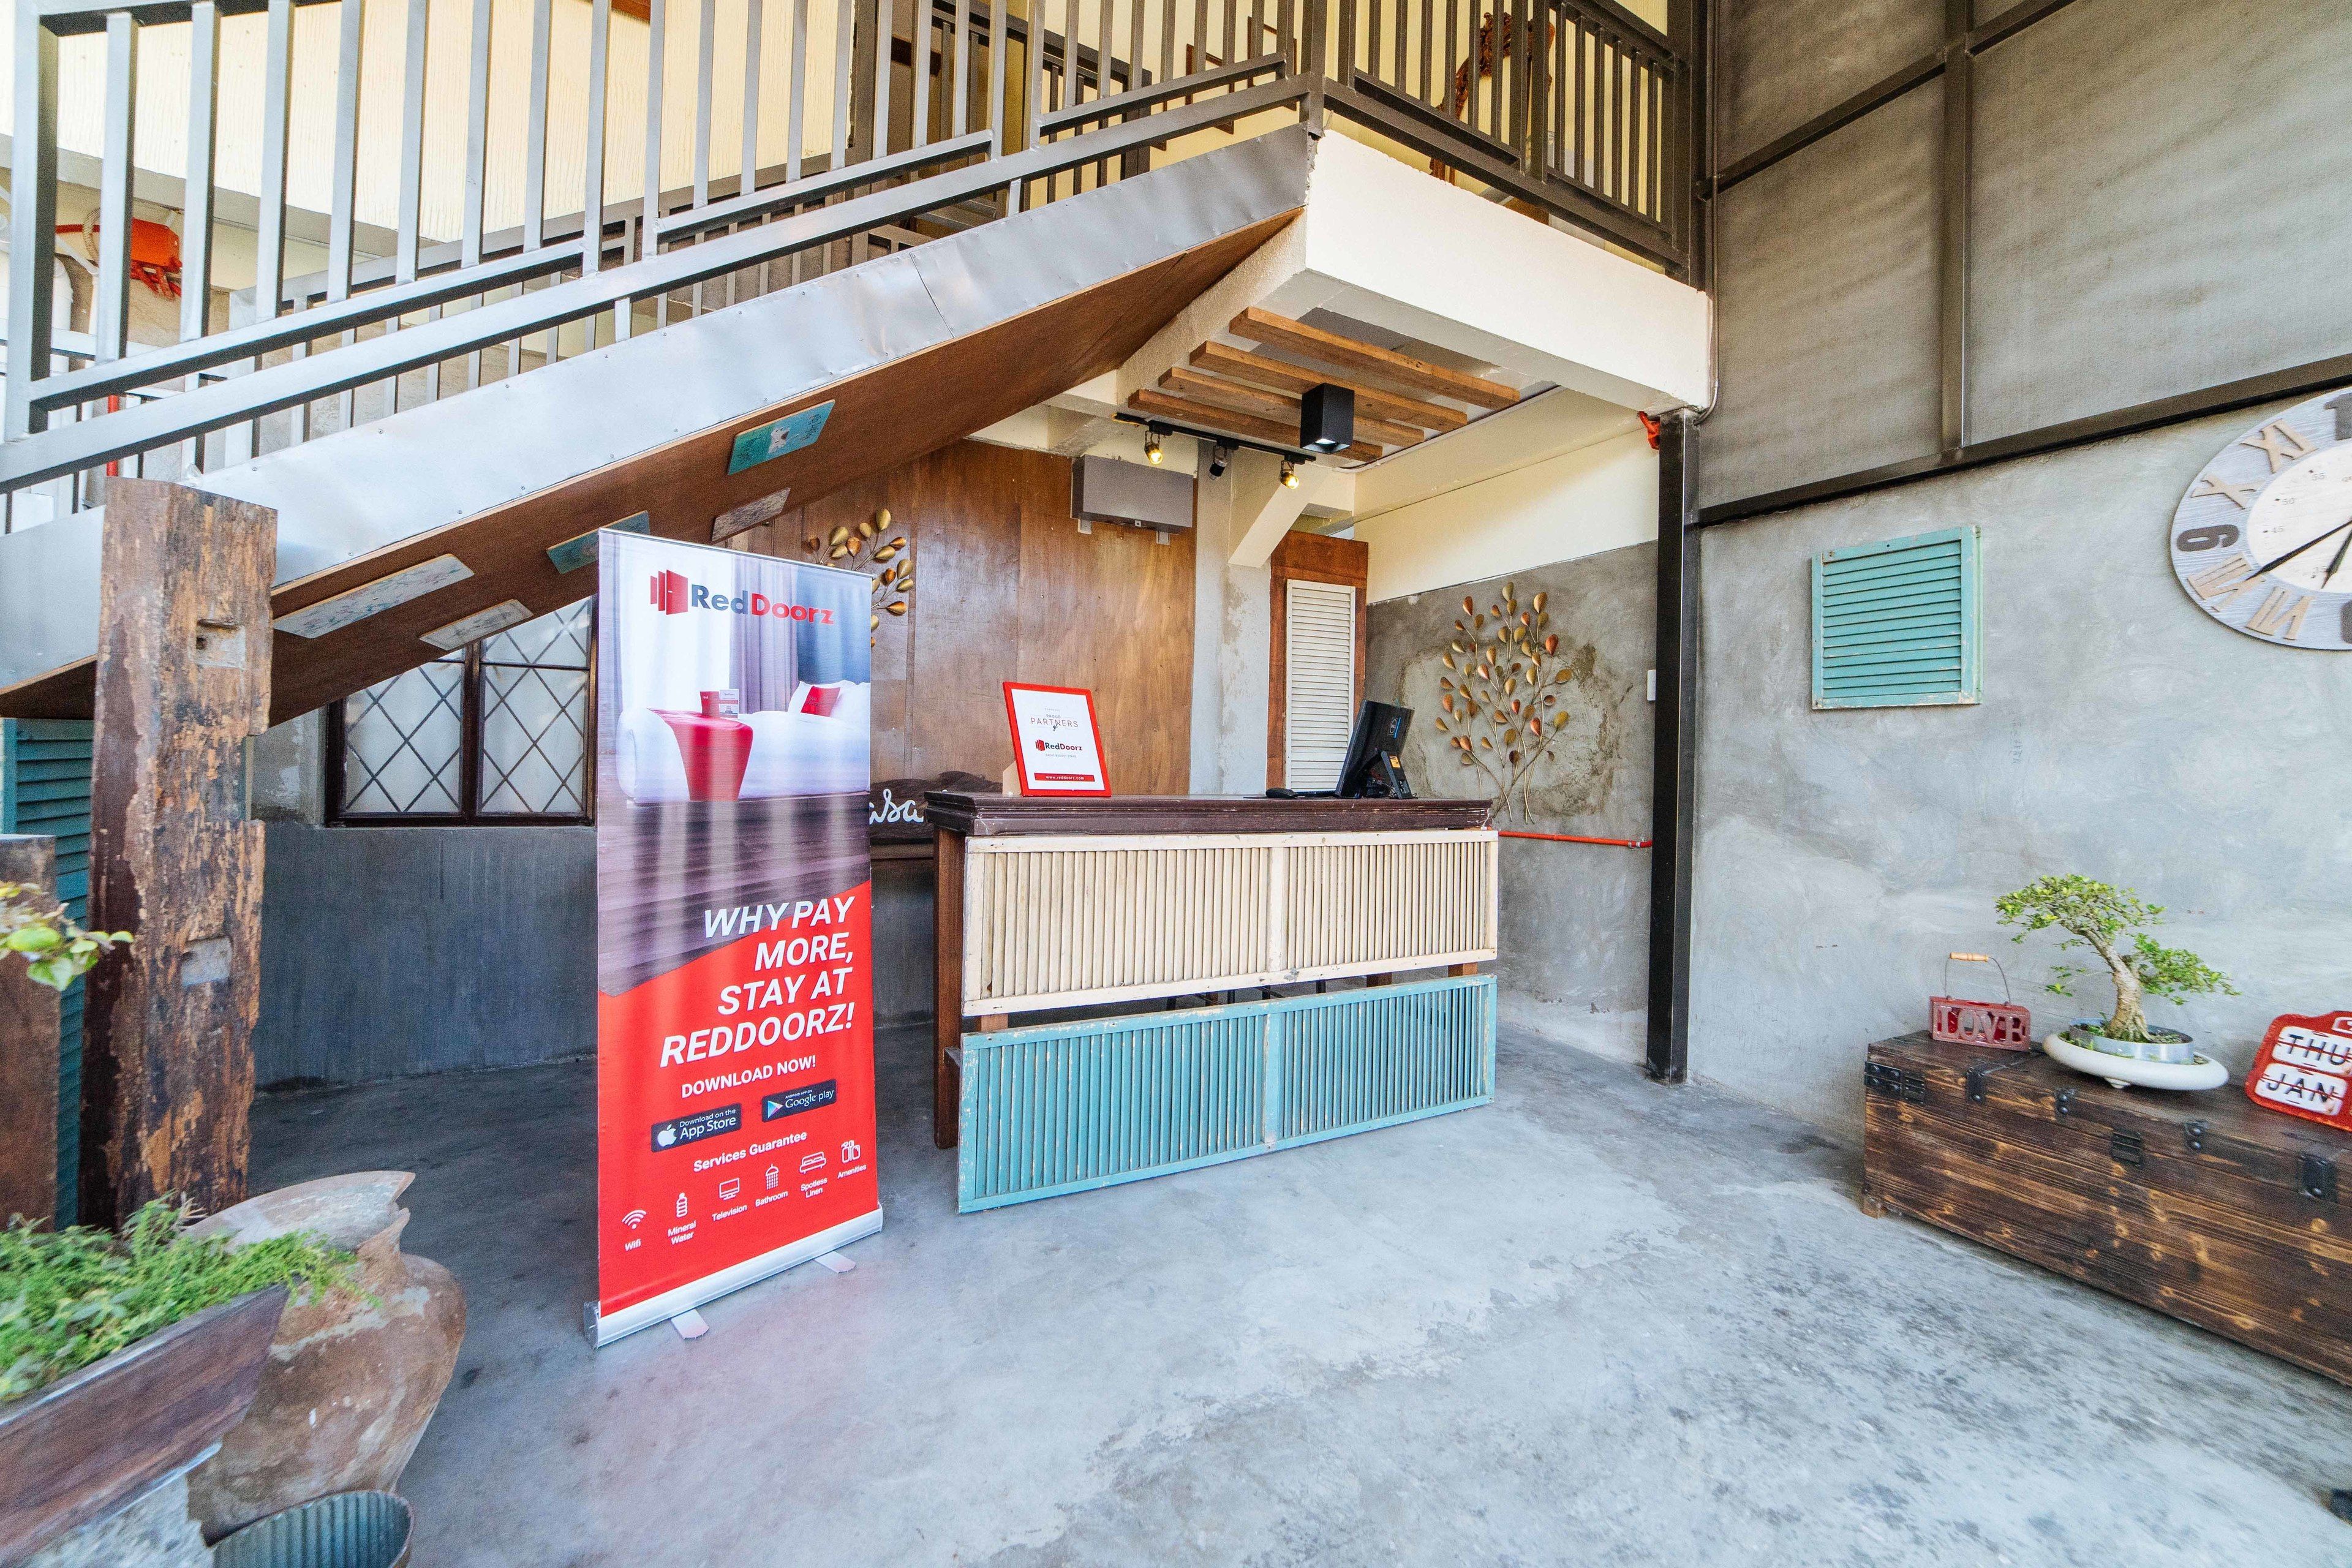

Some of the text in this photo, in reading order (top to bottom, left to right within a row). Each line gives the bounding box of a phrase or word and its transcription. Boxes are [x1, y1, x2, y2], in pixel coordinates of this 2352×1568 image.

[692, 584, 834, 625] RedDoorz
[1030, 717, 1078, 728] PARTNERS
[1045, 742, 1082, 751] RedDoorz
[705, 895, 856, 938] WHY PAY
[754, 932, 853, 971] MORE,
[717, 967, 853, 1016] STAY AT
[1936, 1005, 2024, 1044] LOVE
[660, 1001, 855, 1068] REDDOORZ!
[2288, 1033, 2351, 1066] THU
[681, 1055, 816, 1098] DOWNLOAD NOW!
[2266, 1073, 2335, 1102] JAN
[785, 1090, 834, 1108] Google play
[679, 1113, 714, 1128] Download
[679, 1117, 736, 1140] App Store
[693, 1131, 808, 1172] Services Guarantee
[837, 1164, 867, 1180] Amenities
[800, 1177, 828, 1193] Spotless
[805, 1186, 823, 1199] Linen
[755, 1190, 788, 1208] Bathroom
[712, 1203, 747, 1222] Television
[667, 1221, 696, 1237] Mineral
[671, 1231, 694, 1245] Water
[624, 1238, 641, 1252] Wifi
